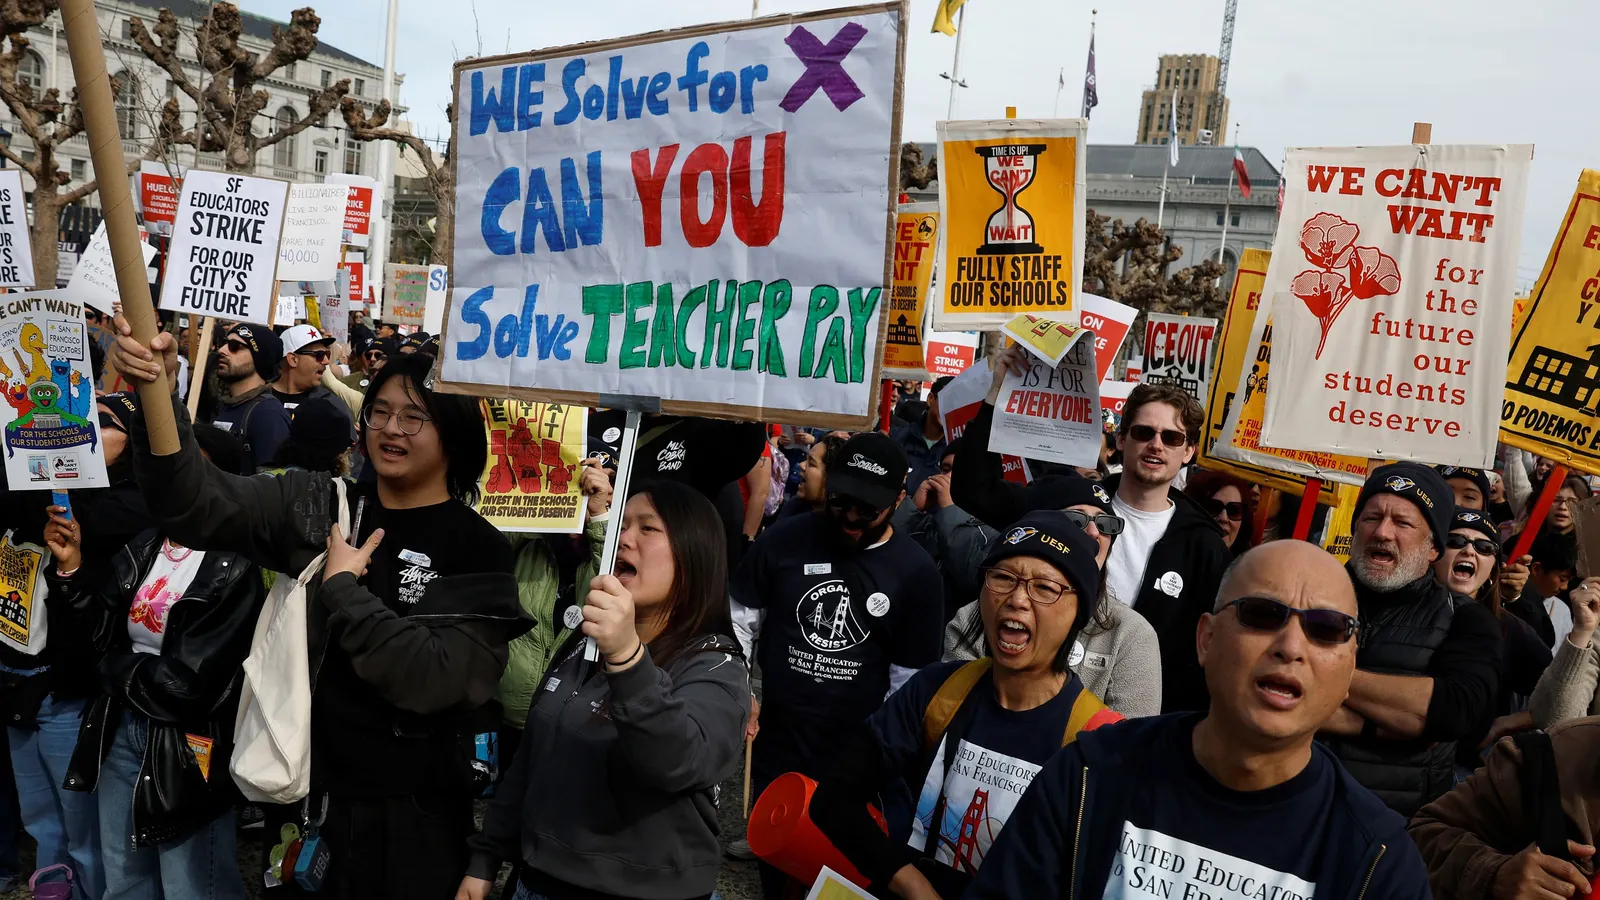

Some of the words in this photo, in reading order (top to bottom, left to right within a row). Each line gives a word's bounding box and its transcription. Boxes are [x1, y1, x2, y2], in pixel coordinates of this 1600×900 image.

[469, 63, 546, 136] WE
[554, 56, 671, 126] Solve
[677, 41, 768, 114] for
[778, 22, 868, 112] X
[991, 146, 1008, 156] TIME
[1009, 146, 1016, 155] IS
[1017, 146, 1028, 155] UP!
[997, 156, 1024, 166] WE
[226, 178, 243, 193] SF
[990, 169, 1031, 186] CAN'T
[1307, 165, 1365, 196] WE
[1375, 168, 1501, 207] CAN'T
[292, 188, 345, 198] BILLIONAIRES
[480, 150, 604, 256] CAN
[630, 130, 786, 248] YOU
[190, 192, 270, 216] EDUCATORS
[288, 206, 304, 214] LIVE
[346, 200, 364, 209] RIKE
[190, 211, 265, 244] STRIKE
[989, 225, 1031, 241] WAIT
[1387, 205, 1494, 244] WAIT
[282, 238, 302, 246] PARAS
[190, 246, 219, 266] FOR
[222, 250, 254, 272] OUR
[895, 243, 930, 262] N'T
[894, 262, 918, 281] AIT
[957, 257, 1005, 281] FULLY
[1011, 256, 1062, 280] STAFF
[1434, 258, 1484, 285] for
[190, 265, 247, 292] CITY'S
[180, 286, 250, 316] FUTURE
[896, 286, 917, 298] SCHOOLS
[951, 282, 984, 306] OUR
[990, 281, 1067, 306] SCHOOLS
[0, 306, 7, 319] E
[8, 298, 41, 314] CAN'T
[44, 299, 81, 318] WAIT!
[898, 299, 917, 311] DESERVE
[1425, 289, 1478, 316] the
[456, 284, 579, 361] Solve
[582, 278, 792, 378] TEACHER
[798, 284, 882, 384] PAY
[1083, 316, 1104, 330] ON
[1370, 312, 1474, 346] future
[2, 328, 17, 339] STAND
[2, 338, 14, 348] WITH
[50, 335, 80, 344] FRANCISCO
[50, 345, 81, 354] EDUCATORS
[944, 346, 958, 355] ON
[1142, 320, 1178, 374] ICE
[1178, 324, 1214, 382] OUT
[934, 356, 964, 368] STRIKE
[1414, 354, 1471, 375] our
[1020, 365, 1043, 387] IS
[1045, 367, 1086, 394] FOR
[1324, 370, 1466, 405] students
[1004, 390, 1092, 424] EVERYONE
[1328, 401, 1461, 438] deserve
[1513, 404, 1591, 446] PODEMOS
[10, 438, 26, 446] OUR
[27, 438, 60, 446] STUDENTS
[62, 433, 92, 444] DESERVE
[20, 430, 33, 438] FOR
[36, 430, 47, 438] THE
[48, 427, 80, 437] SCHOOLS
[657, 448, 686, 461] COBRA
[1280, 449, 1296, 458] FOR
[1298, 452, 1336, 468] STUDENTS
[658, 461, 682, 472] BAND
[1002, 460, 1021, 472] ORA!
[1462, 467, 1479, 477] UESF
[482, 496, 512, 506] INVEST
[512, 496, 522, 506] IN
[523, 496, 539, 506] THE
[539, 496, 578, 506] SCHOOLS
[1416, 488, 1434, 509] UESF
[480, 506, 496, 517] OUR
[496, 506, 537, 518] STUDENTS
[540, 508, 576, 518] DESERVE!
[1483, 519, 1497, 534] UESF
[1041, 534, 1070, 555] UESF
[810, 585, 850, 601] ORGAN
[809, 632, 847, 648] RESIST
[788, 646, 813, 660] UNITED
[797, 659, 812, 669] SAN
[814, 662, 858, 675] FRANCISCO
[978, 752, 1036, 782] EDUCATORS
[972, 765, 1027, 795] FRANCISCO
[313, 852, 330, 879] JBL
[1129, 866, 1174, 900] SAN
